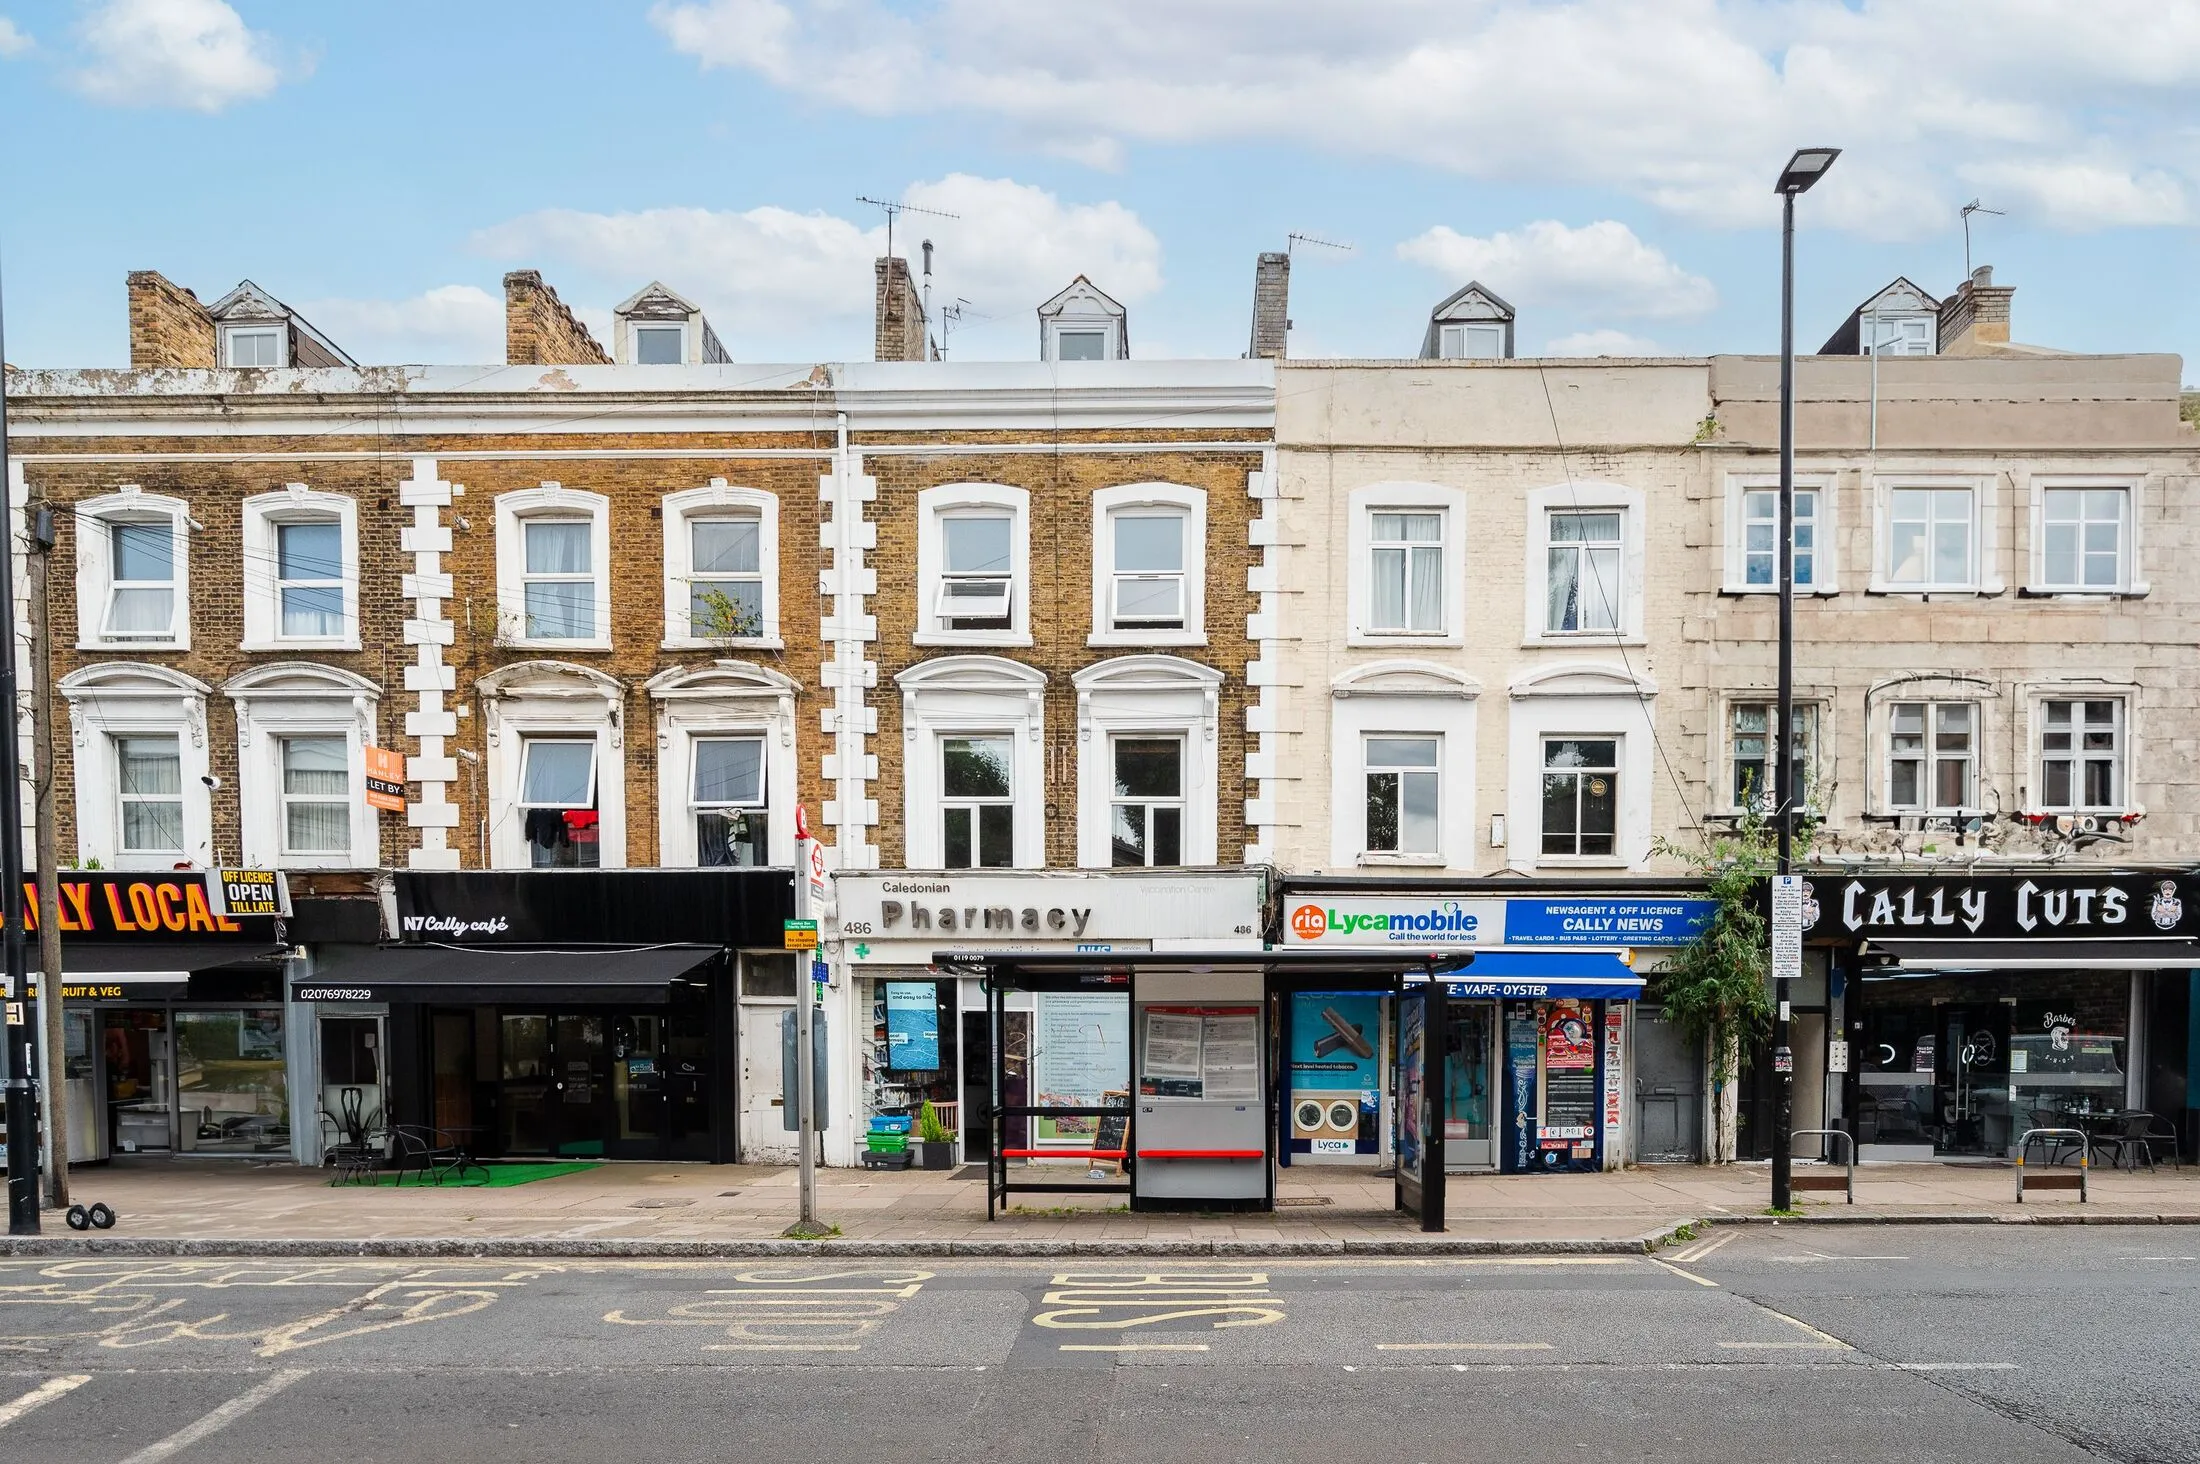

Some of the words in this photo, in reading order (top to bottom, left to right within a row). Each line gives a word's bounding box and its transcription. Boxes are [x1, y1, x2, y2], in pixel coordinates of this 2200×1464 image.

[370, 779, 386, 791] LET
[387, 784, 401, 795] BY
[222, 870, 239, 883] OFF
[240, 871, 275, 884] LICENCE
[228, 883, 274, 901] OPEN
[882, 881, 950, 894] Caledonian
[230, 901, 252, 913] TILL
[252, 901, 276, 913] LATE
[1546, 906, 1606, 915] NEWSAGENT
[1609, 906, 1617, 915] &
[1619, 906, 1638, 915] OFF
[1640, 906, 1683, 915] LICENCE
[2015, 879, 2129, 932] CUTS
[881, 900, 1092, 938] Pharmacy
[1294, 908, 1324, 928] ria
[1328, 908, 1478, 935] Lycamobile
[1562, 918, 1611, 931] CALLY
[1616, 918, 1664, 931] NEWS
[404, 916, 425, 932] N7
[425, 915, 470, 937] Cally
[470, 915, 509, 935] café
[843, 921, 872, 935] 486
[1233, 925, 1252, 935] 486
[1388, 932, 1405, 941] Call
[1406, 932, 1421, 941] the
[1421, 932, 1446, 941] world
[1446, 932, 1459, 941] for
[1459, 932, 1477, 941] less
[61, 986, 87, 997] RUIT
[88, 986, 98, 997] &
[100, 986, 122, 997] VEG
[300, 989, 371, 1000] 02076978229
[1503, 984, 1549, 997] OYSTER
[2043, 1011, 2077, 1029] Barber
[1317, 1140, 1341, 1150] Lyca
